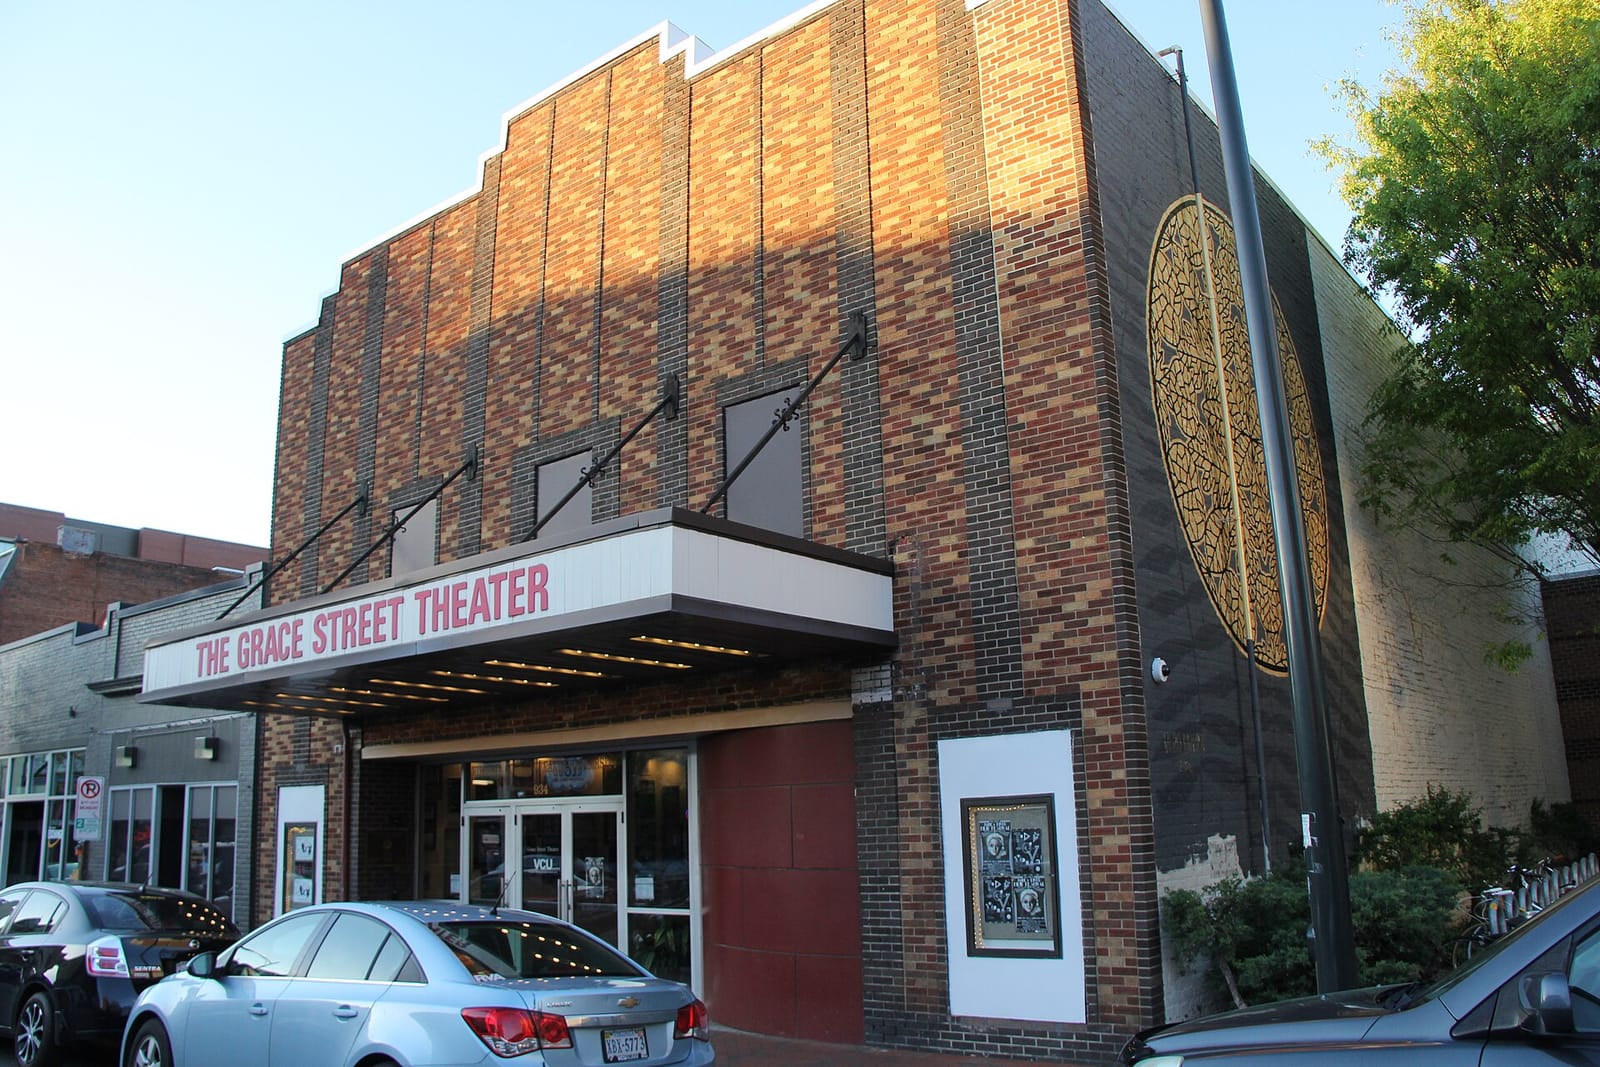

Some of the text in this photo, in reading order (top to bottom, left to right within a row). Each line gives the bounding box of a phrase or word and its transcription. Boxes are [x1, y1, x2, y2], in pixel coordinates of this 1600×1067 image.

[196, 563, 549, 678] THE GRACE STREET THEATER
[77, 819, 84, 828] 2
[533, 858, 553, 869] VCU
[606, 1036, 645, 1054] XBX-5773
